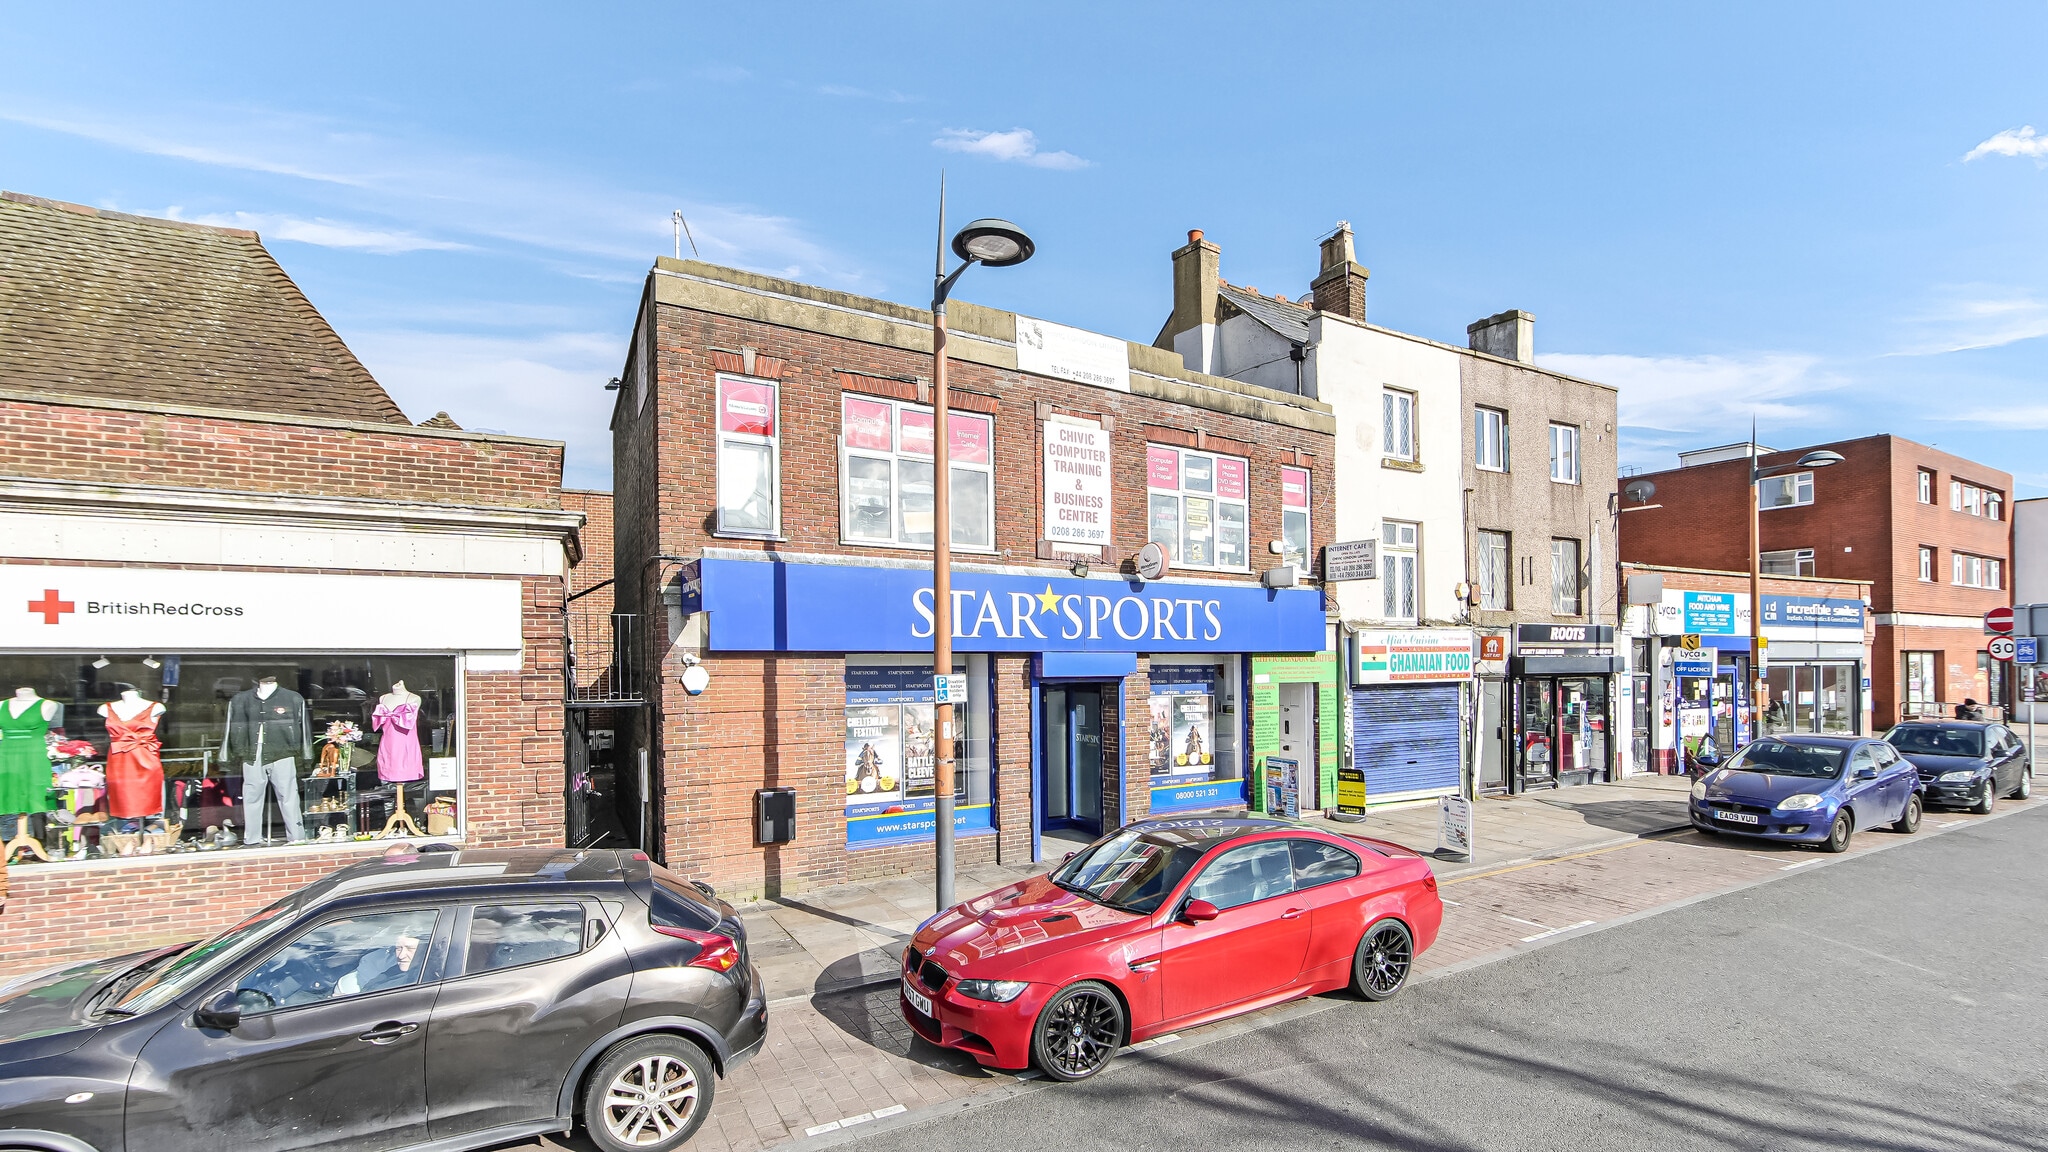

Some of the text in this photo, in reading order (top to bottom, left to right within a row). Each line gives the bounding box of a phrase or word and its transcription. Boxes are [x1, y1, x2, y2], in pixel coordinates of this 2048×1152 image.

[1051, 365, 1060, 374] TEL
[1059, 429, 1095, 446] CHIVIC
[1048, 443, 1106, 462] COMPUTER
[1149, 455, 1173, 466] Computer
[1053, 459, 1102, 477] TRAINING
[1155, 464, 1169, 472] Sales
[1222, 463, 1237, 471] Mobile
[1156, 472, 1173, 481] Repair
[1221, 471, 1238, 479] Phones
[1075, 478, 1083, 491] &
[1229, 479, 1241, 487] Sales
[1054, 491, 1103, 509] BUSINESS
[1059, 508, 1098, 524] CENTRE
[1051, 526, 1105, 539] 0208 286 3697
[1658, 605, 1676, 616] Lyca
[1689, 602, 1704, 611] FOOD
[1704, 603, 1716, 611] AND
[1786, 602, 1860, 617] incredible smiles
[911, 587, 1222, 642] STAR SPORTS
[1409, 634, 1439, 645] Cuisine
[1550, 626, 1586, 641] ROOTS
[1680, 650, 1700, 658] Lyca
[1991, 643, 2014, 654] 30
[1390, 653, 1470, 673] GHANAIAN FOOD
[847, 716, 889, 728] CHELTENHAM
[853, 727, 884, 738] FESTIVAL
[908, 756, 935, 768] BATTLE
[908, 767, 935, 779] CLEEVE
[1175, 792, 1194, 800] 08000
[1207, 788, 1218, 796] 321
[1720, 811, 1757, 823] EA09 VUU
[915, 994, 929, 1013] GWU
